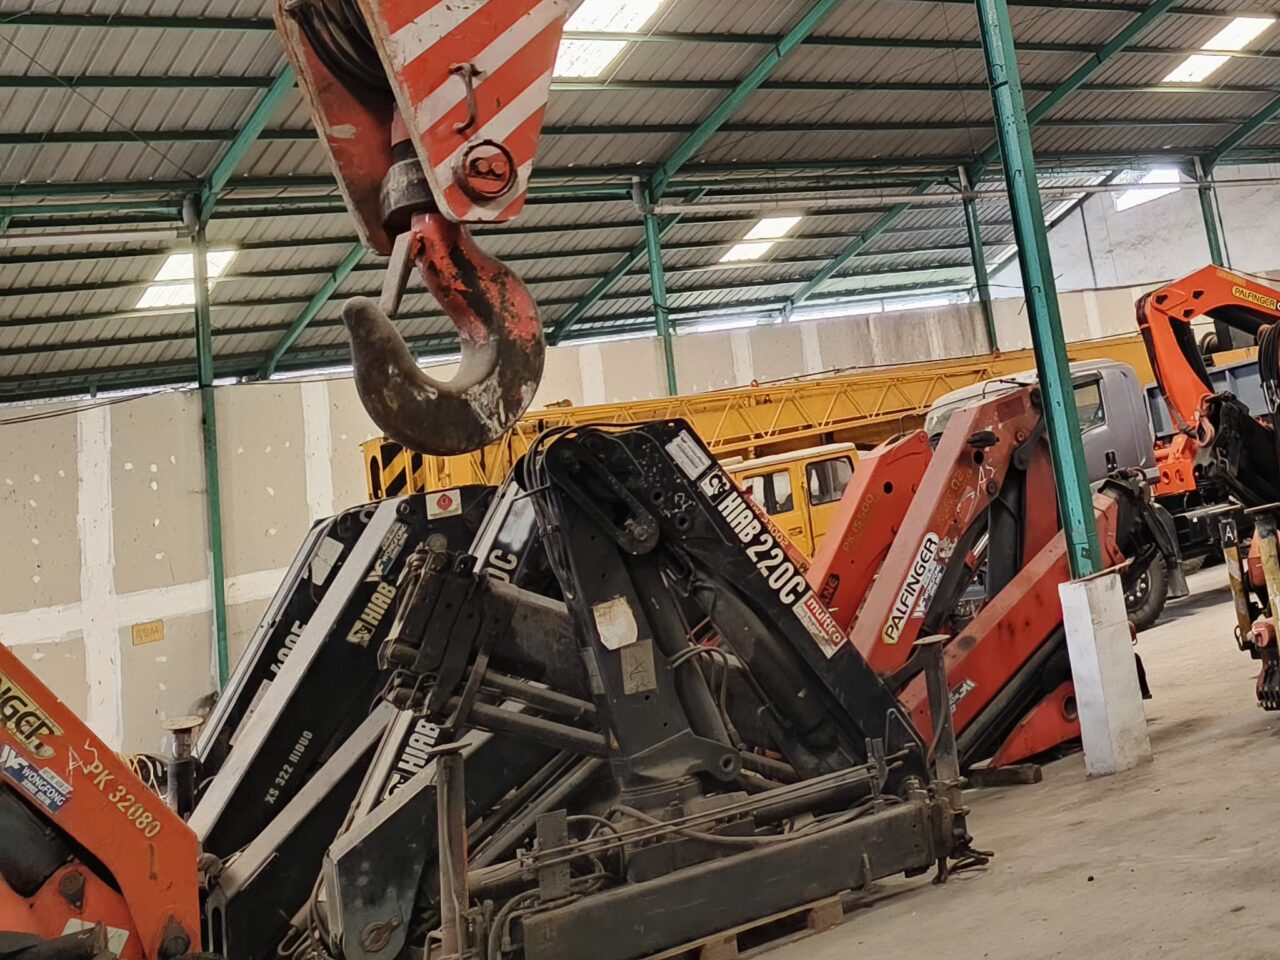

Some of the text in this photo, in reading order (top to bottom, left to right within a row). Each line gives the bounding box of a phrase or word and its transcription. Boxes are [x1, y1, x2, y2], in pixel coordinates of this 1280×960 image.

[1234, 287, 1276, 309] PALFINGER
[717, 491, 806, 606] HIAB 220C
[1224, 525, 1234, 542] A
[361, 582, 397, 627] HIAB
[885, 537, 938, 640] PALFINGER
[806, 598, 842, 642] multico
[398, 718, 440, 774] HIAB
[22, 765, 66, 807] WONGFONG
[84, 760, 161, 838] PK 32080
[264, 788, 280, 805] XS
[275, 763, 294, 788] 322
